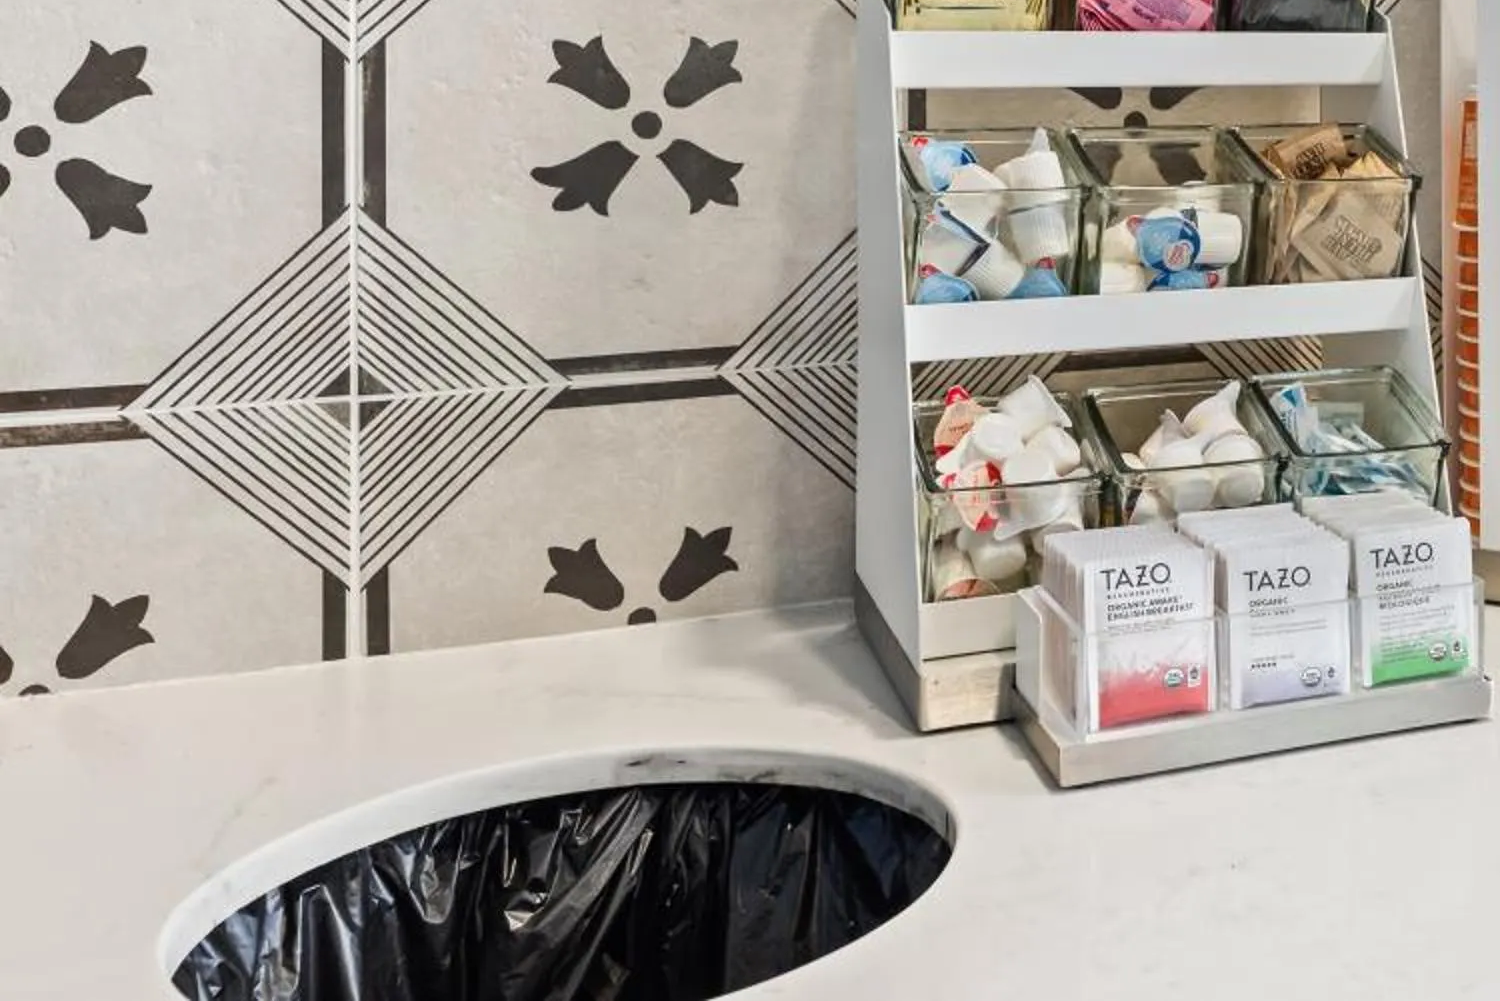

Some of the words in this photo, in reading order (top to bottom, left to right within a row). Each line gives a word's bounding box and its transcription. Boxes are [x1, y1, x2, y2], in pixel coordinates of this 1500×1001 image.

[1369, 542, 1433, 569] TAZO
[1099, 562, 1171, 591] TAZO
[1242, 566, 1311, 592] TAZO
